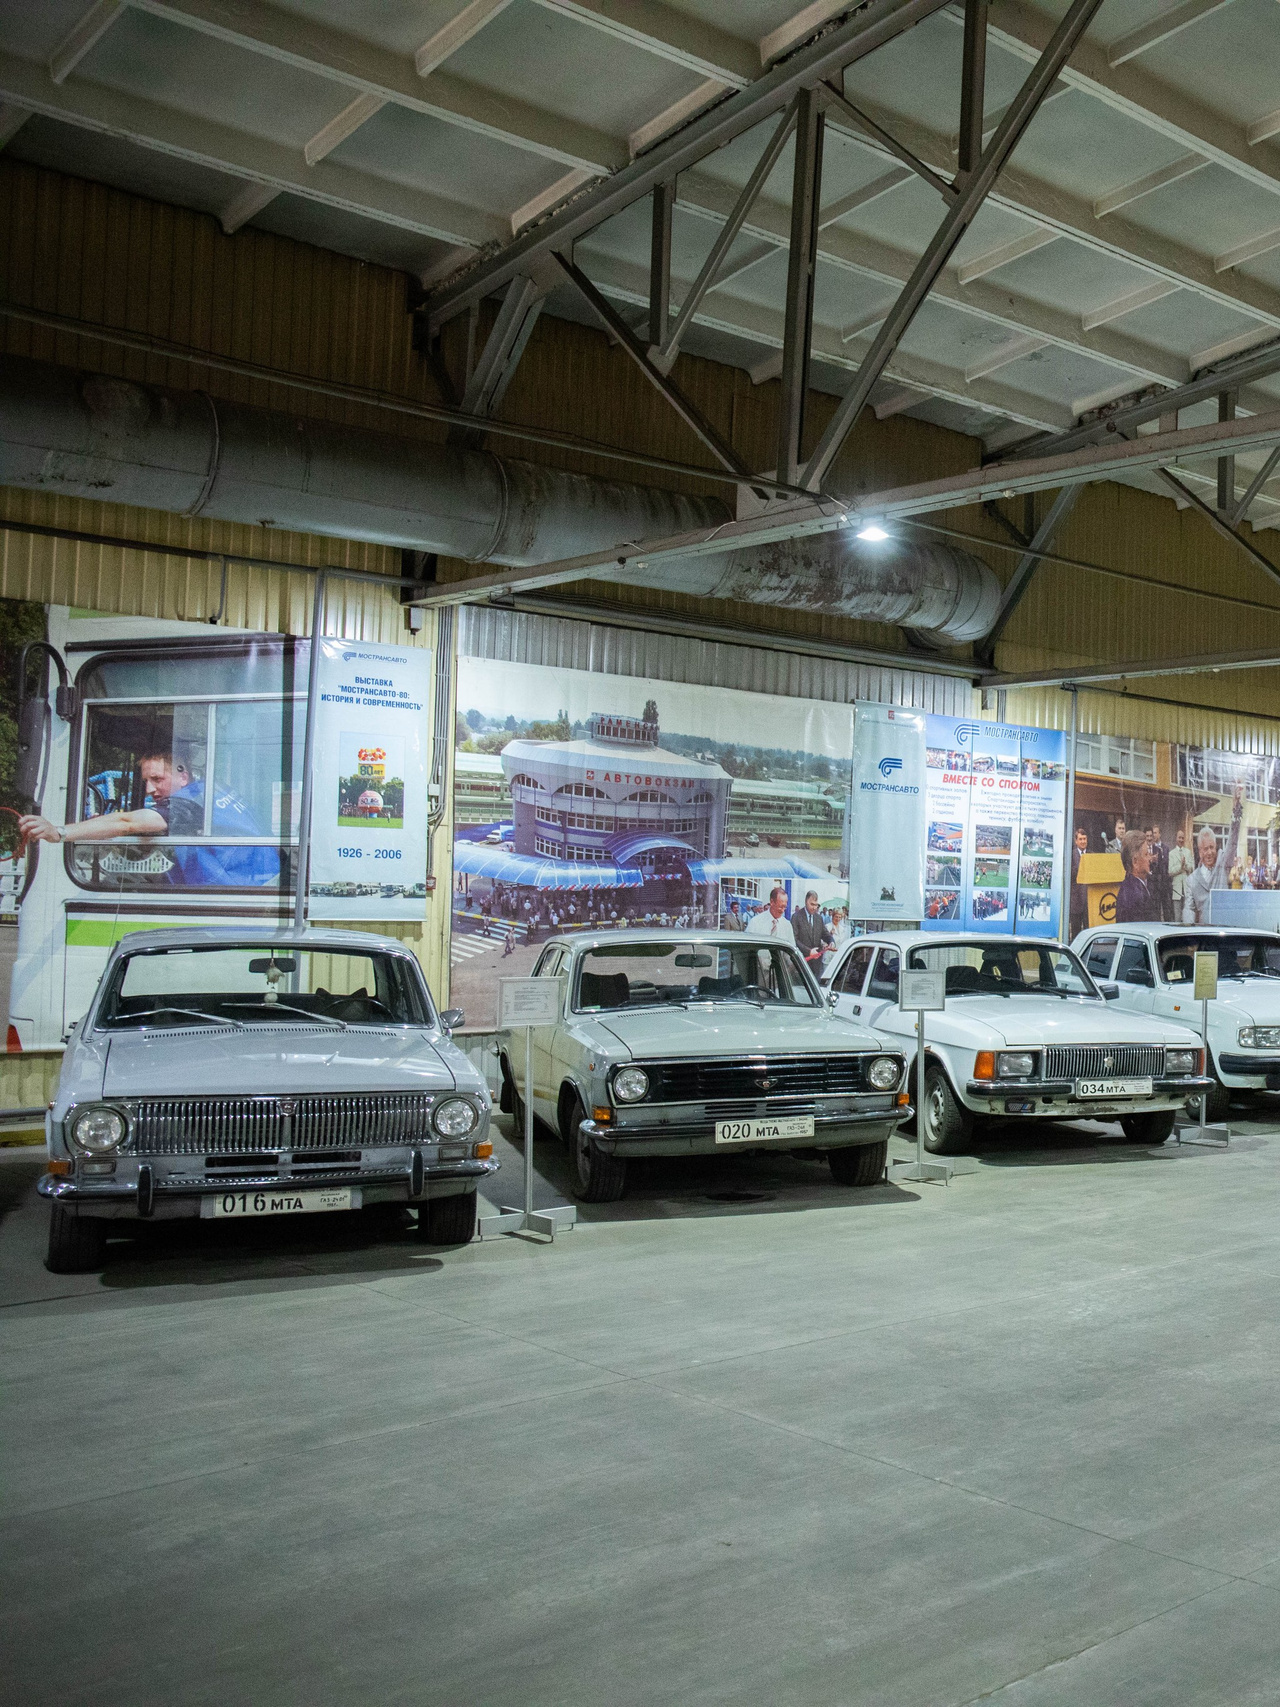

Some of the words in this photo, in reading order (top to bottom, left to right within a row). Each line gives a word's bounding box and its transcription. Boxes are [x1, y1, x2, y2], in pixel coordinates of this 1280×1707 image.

[358, 652, 407, 664] МОСТРАНСАВТО
[355, 676, 393, 687] ВЫСТАВКА
[338, 685, 410, 700] "МОСТРАНСАВТО-80:
[321, 693, 354, 704] ИСТОРИЯ
[362, 698, 423, 711] СОВРЕМЕННОСТЬ"
[984, 726, 1039, 743] МОСТРАНСАВТО
[360, 765, 373, 776] 80
[604, 773, 695, 789] АВТОВОКЗАЛ
[860, 782, 919, 794] МОСТРАНСАВТО
[942, 773, 977, 786] ВМЕСТЕ
[982, 777, 995, 788] СО
[998, 779, 1040, 792] СПОРТОМ
[337, 848, 362, 859] 1926
[374, 849, 402, 860] 2006
[722, 1123, 750, 1140] 020
[756, 1126, 780, 1137] МТА
